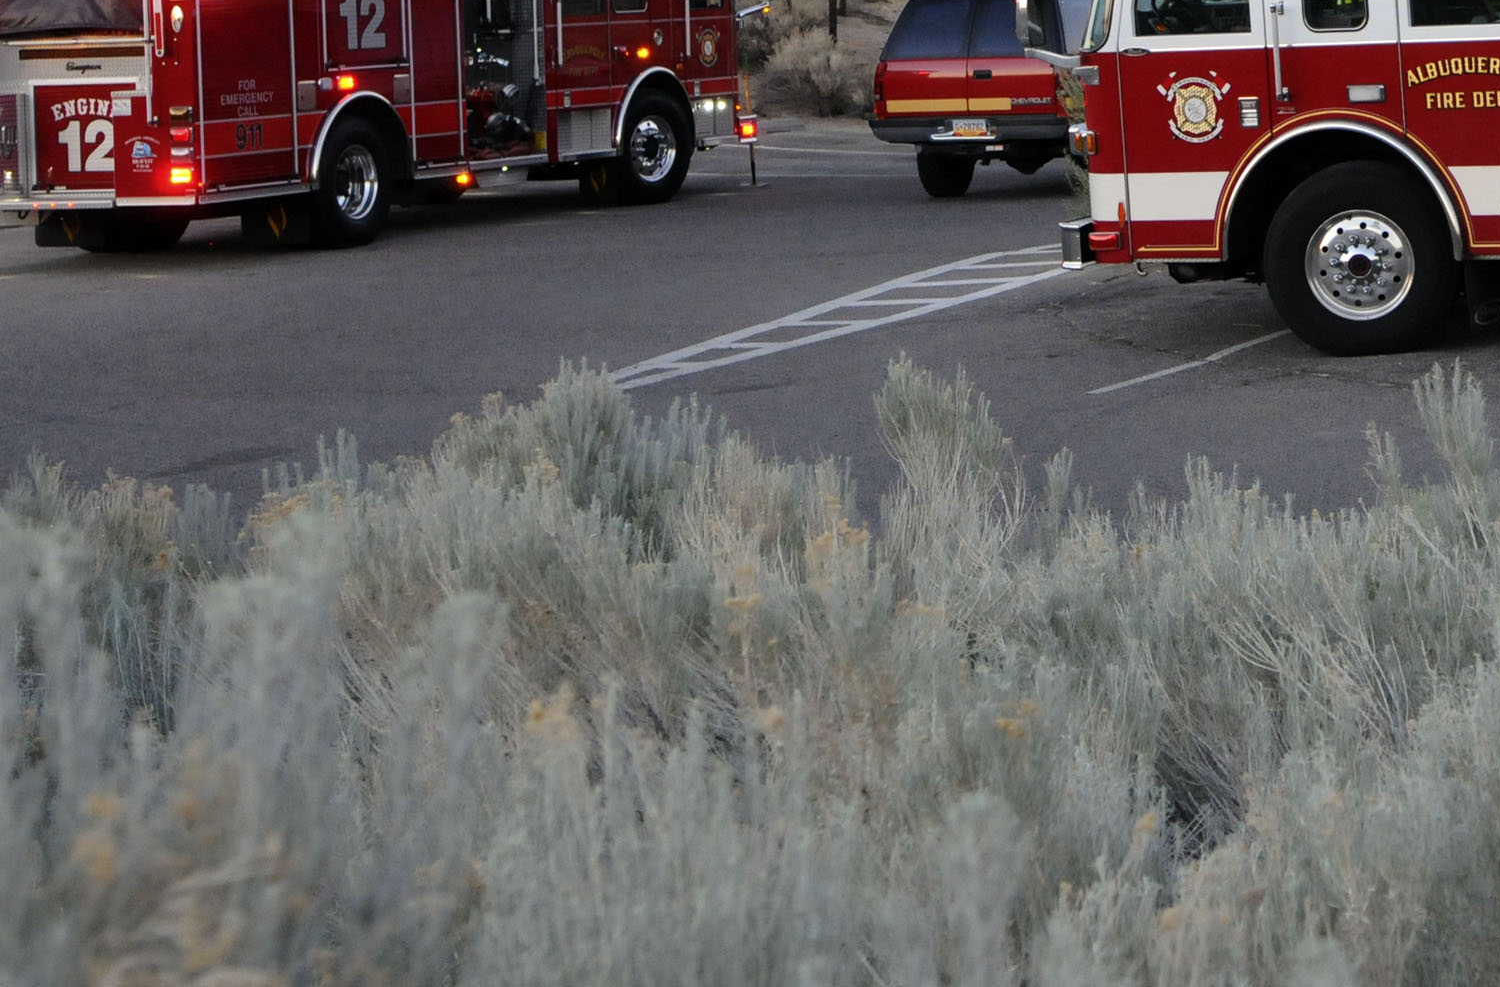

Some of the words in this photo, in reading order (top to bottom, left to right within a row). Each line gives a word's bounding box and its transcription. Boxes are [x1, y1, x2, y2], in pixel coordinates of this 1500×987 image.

[238, 79, 256, 91] FOR
[220, 91, 274, 106] EMERGENCY
[1425, 92, 1466, 109] FIRE
[50, 98, 113, 122] ENGIN
[237, 106, 259, 117] CALL
[58, 118, 115, 172] 12
[235, 123, 264, 150] 911
